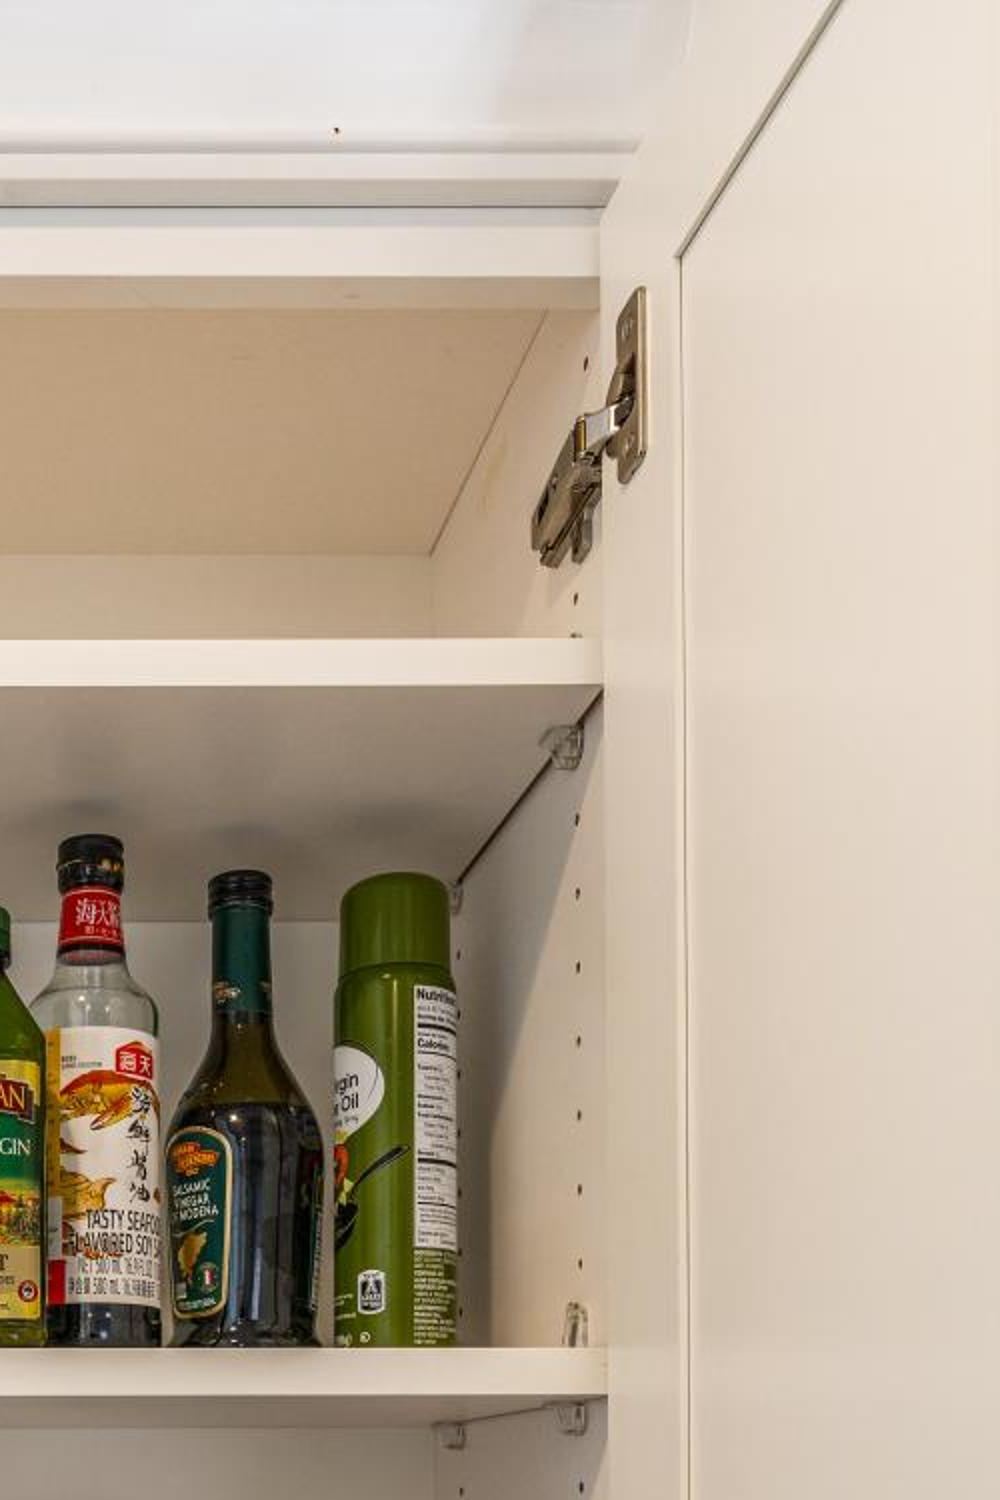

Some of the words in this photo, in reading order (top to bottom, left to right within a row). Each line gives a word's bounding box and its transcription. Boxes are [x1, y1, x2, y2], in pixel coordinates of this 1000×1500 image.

[341, 1093, 359, 1112] Oil
[86, 1208, 125, 1229] TASTY
[179, 1205, 219, 1222] MODENA
[68, 1232, 134, 1254] FLAVORED
